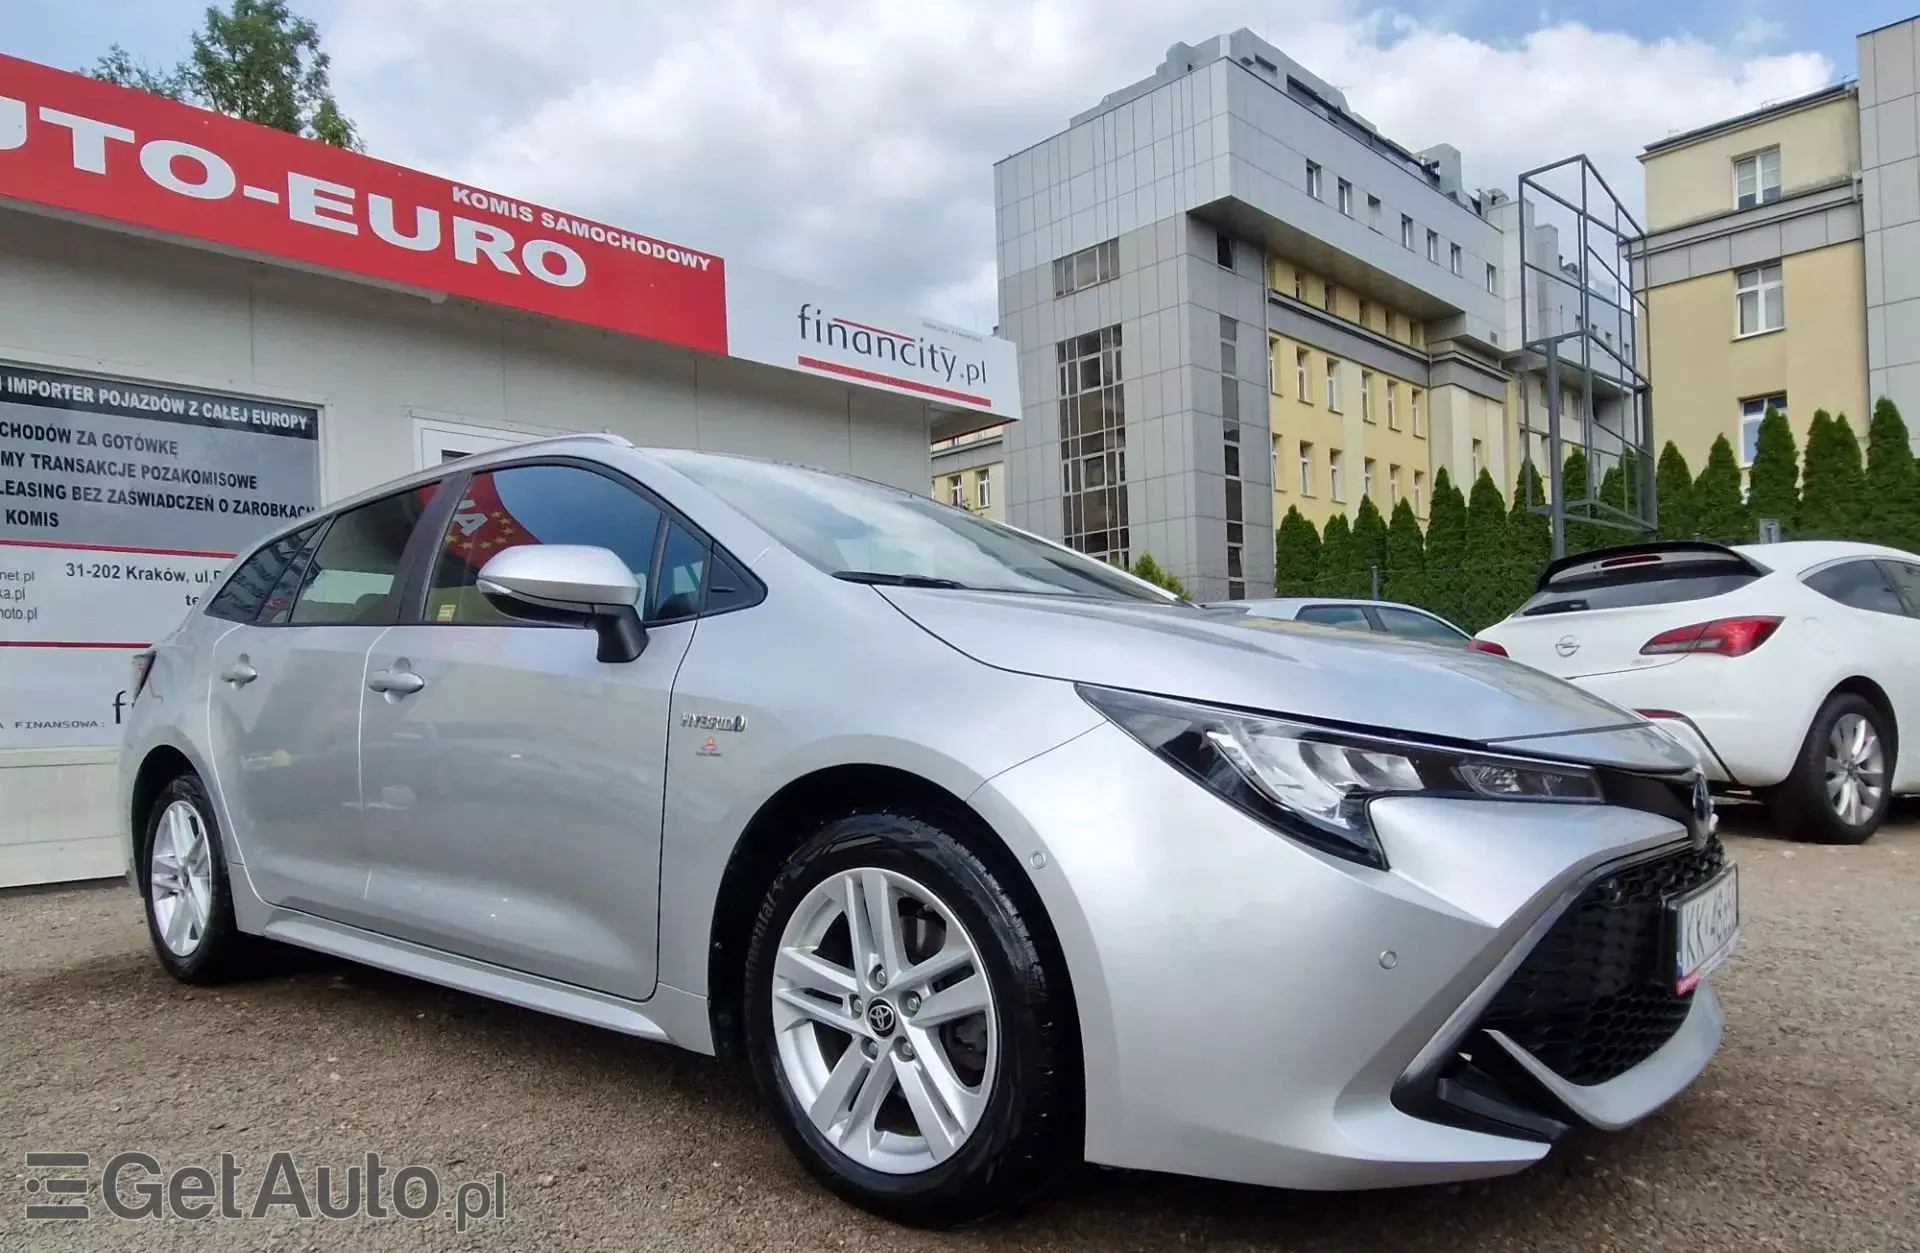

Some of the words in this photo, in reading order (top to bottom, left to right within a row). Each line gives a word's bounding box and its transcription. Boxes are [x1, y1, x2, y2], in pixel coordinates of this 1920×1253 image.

[452, 186, 534, 223] KOMIS
[541, 212, 711, 272] SAMOCHODOWY
[797, 303, 986, 386] financity.pl
[7, 376, 95, 404] IMPORTER
[99, 388, 185, 417] POJAZDÓW
[188, 401, 199, 417] Z
[203, 403, 248, 424] CAŁEJ
[251, 409, 308, 431] EUROPY
[76, 429, 98, 447] ZA
[102, 432, 179, 459] GOTÓWKĘ
[0, 450, 25, 468] MY
[31, 453, 136, 478] TRANSAKCJE
[141, 467, 258, 490] POZAKOMISOWE
[72, 485, 103, 503] BEZ
[107, 487, 215, 512] ZAŚWIADCZEŃ
[219, 499, 229, 513] O
[6, 508, 60, 528] KOMIS
[65, 562, 121, 580] 31-202
[126, 566, 190, 585] Kraków,
[14, 720, 105, 730] FINANSOWA:
